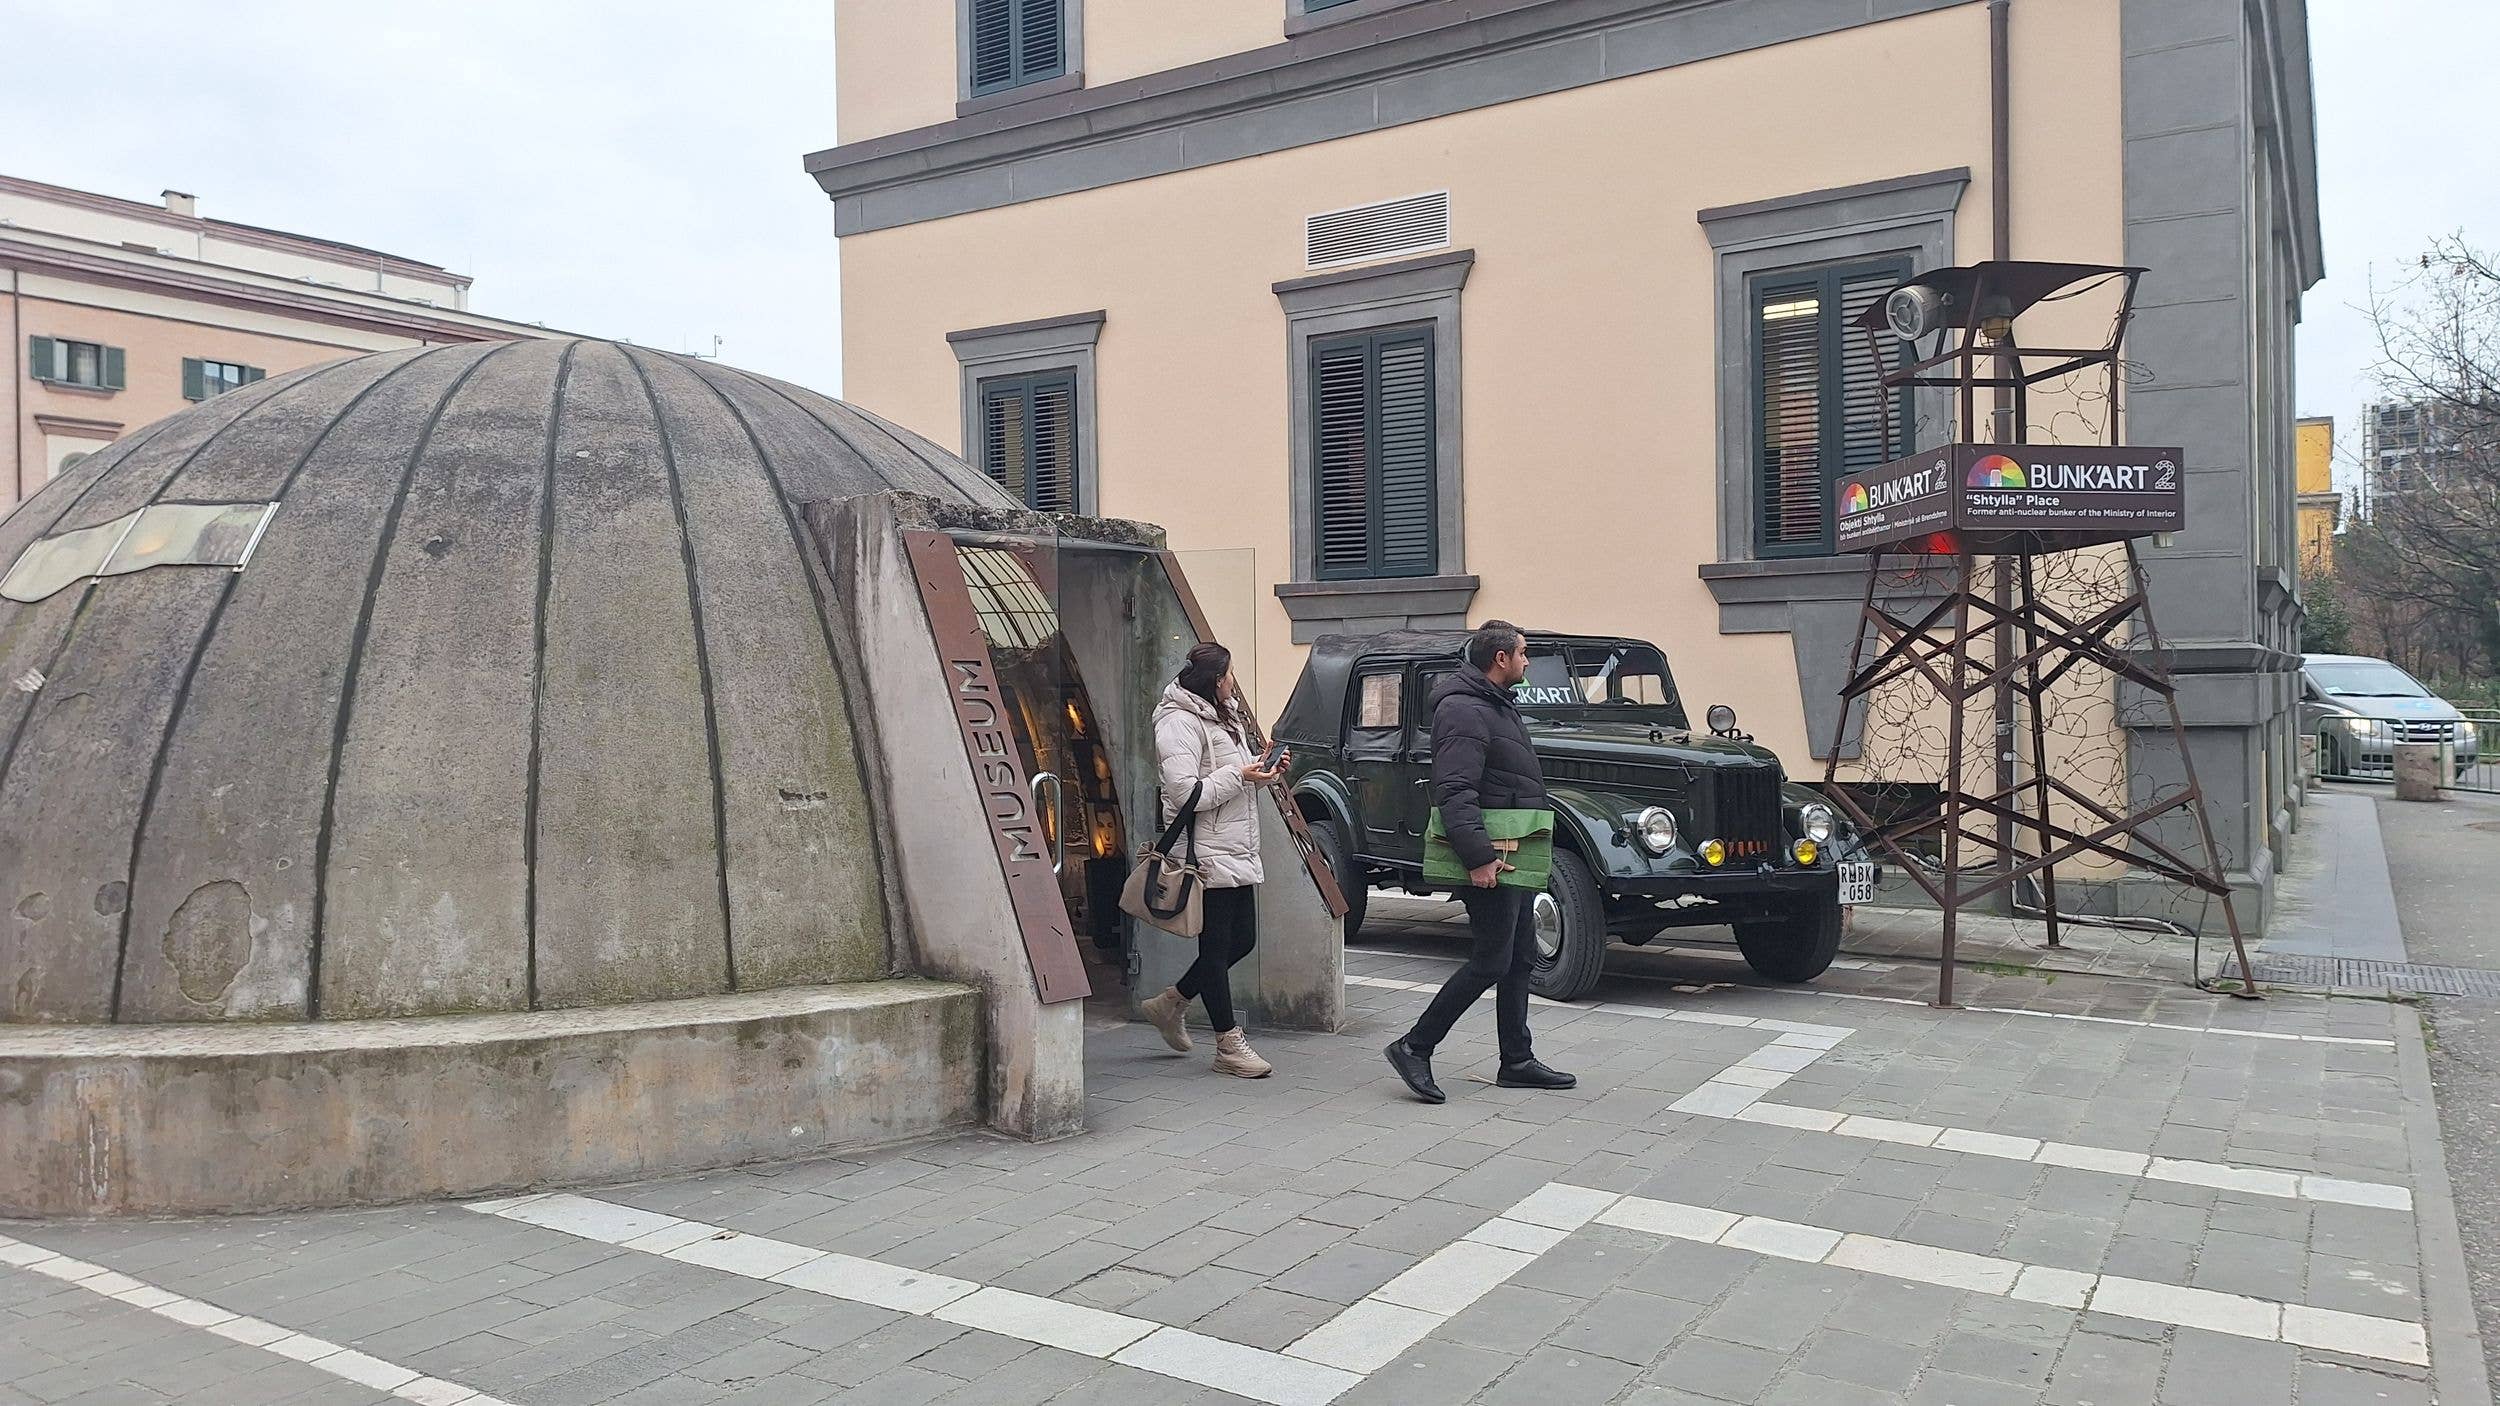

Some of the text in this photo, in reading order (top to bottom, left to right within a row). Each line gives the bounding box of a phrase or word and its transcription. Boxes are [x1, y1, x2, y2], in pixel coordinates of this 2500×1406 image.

[1870, 460, 1948, 509] BUNK'ART 2
[2030, 459, 2176, 490] BUNK'ART 2
[2026, 495, 2060, 506] Place
[1839, 512, 1885, 532] Objekti Shtylla
[1967, 508, 2177, 519] Former anti-nuclear bunker of the Ministry of Interior
[1512, 687, 1571, 703] NK'ART
[951, 659, 1040, 862] MUSEUM
